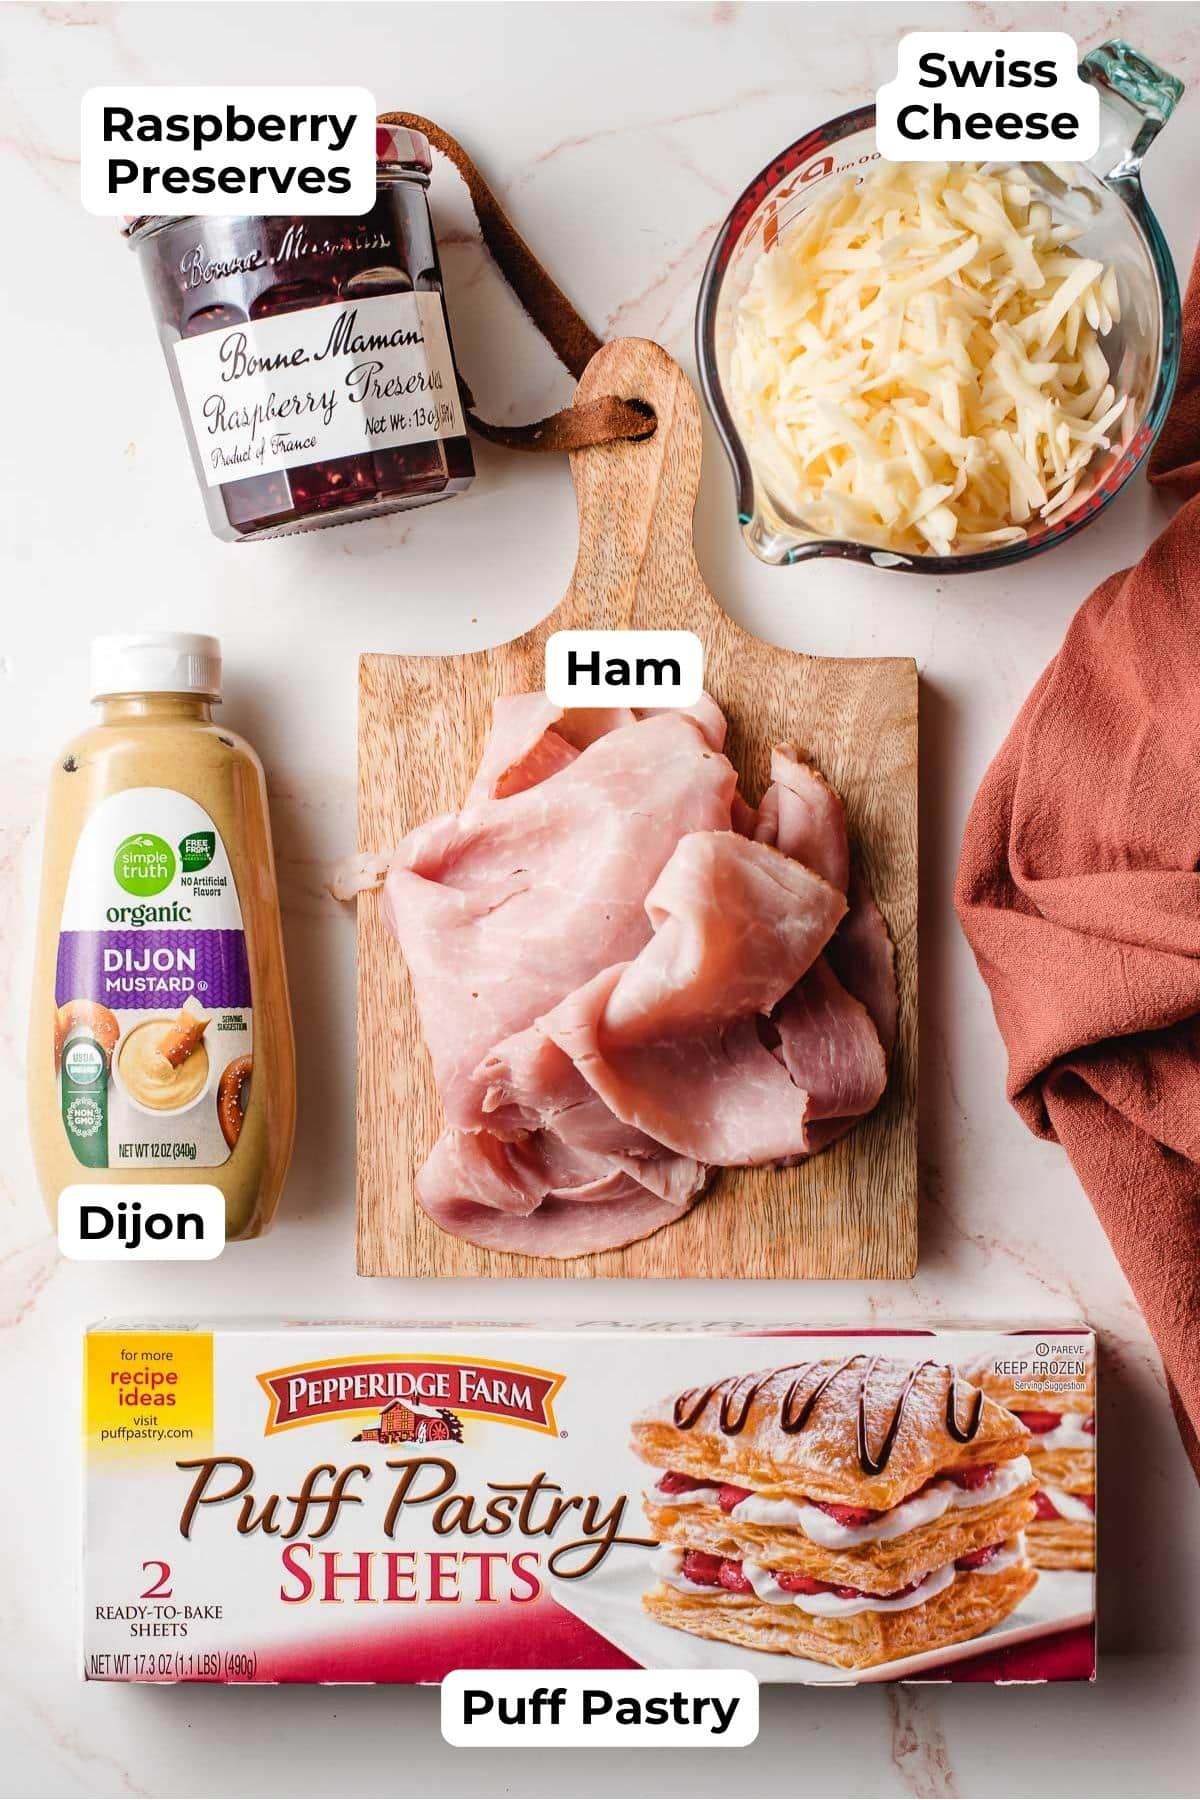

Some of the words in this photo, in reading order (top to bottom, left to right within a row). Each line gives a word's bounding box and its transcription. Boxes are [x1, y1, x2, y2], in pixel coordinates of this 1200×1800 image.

[219, 332, 309, 382] Bonne
[314, 309, 424, 361] Maman
[203, 388, 338, 440] Raspberry
[345, 361, 443, 403] Preserves
[365, 417, 387, 435] Net
[413, 407, 426, 427] 13
[211, 446, 250, 469] Product
[256, 438, 266, 465] of
[272, 432, 317, 455] France
[185, 839, 208, 847] FREE
[122, 852, 168, 867] simple
[123, 863, 168, 878] truth
[181, 877, 192, 886] NO
[193, 876, 227, 887] Artificial
[193, 887, 221, 897] Flavors
[106, 901, 191, 927] organic
[104, 948, 196, 972] DIJON
[106, 977, 195, 992] MUSTARD
[217, 1022, 247, 1031] SUGGESTION
[222, 1015, 243, 1023] SERVING
[73, 1053, 95, 1062] USDA
[74, 1109, 94, 1117] NON
[75, 1116, 94, 1125] GMO
[119, 1144, 133, 1158] NET
[135, 1144, 149, 1158] WT
[151, 1144, 160, 1158] 12
[161, 1144, 172, 1158] OZ
[172, 1143, 197, 1160] (340g)
[121, 1349, 138, 1361] for
[141, 1352, 174, 1361] more
[1051, 1345, 1085, 1354] PAREVE
[994, 1361, 1028, 1375] KEEP
[1032, 1361, 1085, 1375] FROZEN
[110, 1367, 178, 1390] recipe
[1015, 1380, 1043, 1392] Serving
[1044, 1380, 1085, 1392] Suggestion
[118, 1388, 176, 1406] ideas
[287, 1370, 450, 1414] PEPPERIDGE
[458, 1369, 534, 1411] FARM
[133, 1415, 158, 1426] visit
[101, 1426, 193, 1442] puffpastry.com
[175, 1456, 371, 1541] Puff
[385, 1456, 662, 1579] Pastry
[140, 1561, 173, 1599] 2
[279, 1543, 544, 1605] SHEETS
[95, 1606, 223, 1620] READY-TO-BAKE
[130, 1623, 188, 1637] SHEETS
[91, 1654, 111, 1675] NET
[113, 1654, 131, 1675] WT
[134, 1654, 155, 1675] 17.3
[158, 1654, 172, 1675] OZ
[175, 1651, 193, 1677] (1.1
[197, 1651, 221, 1677] LBS)
[225, 1651, 257, 1680] (490g)
